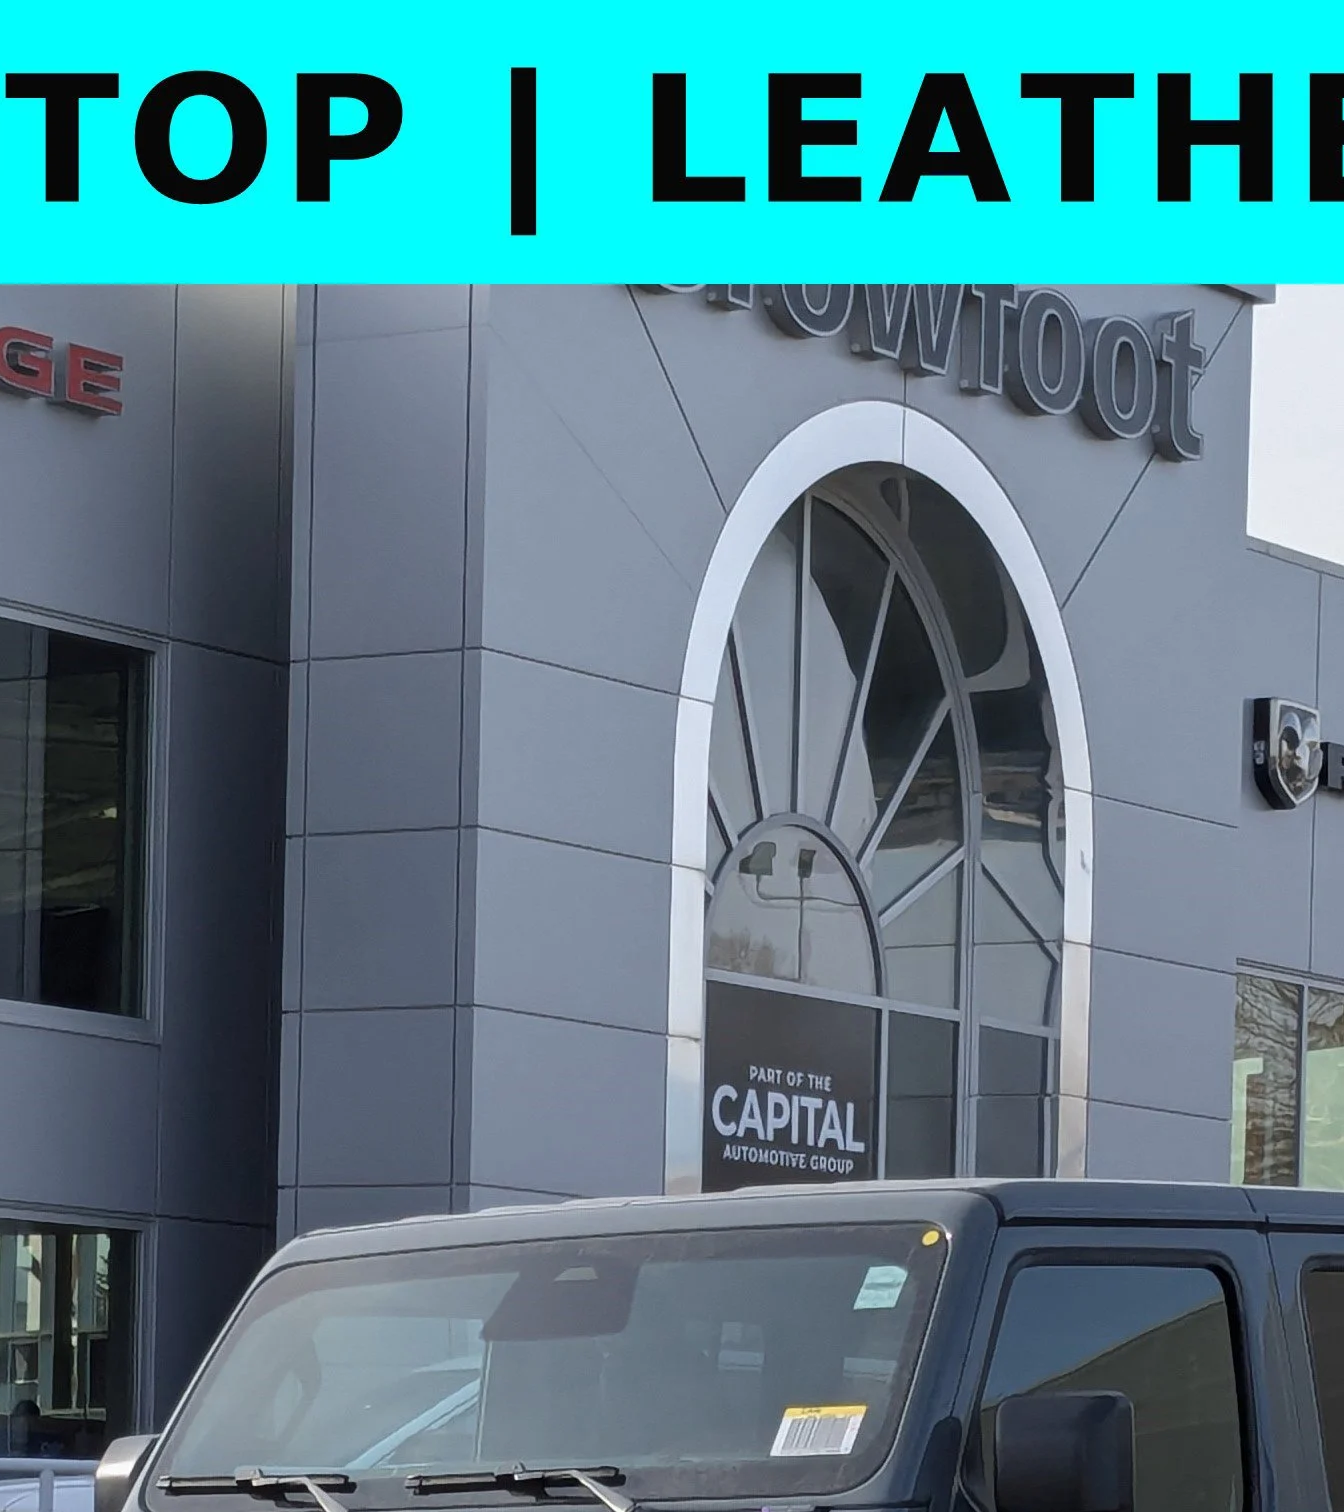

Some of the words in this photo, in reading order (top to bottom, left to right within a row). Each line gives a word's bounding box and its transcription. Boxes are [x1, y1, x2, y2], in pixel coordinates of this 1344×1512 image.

[749, 1065, 783, 1085] PART
[786, 1071, 804, 1088] OF
[807, 1074, 833, 1092] THE
[712, 1084, 865, 1153] CAPITAL
[722, 1144, 807, 1169] AUTOMOTIVE
[810, 1154, 855, 1175] GROUP
